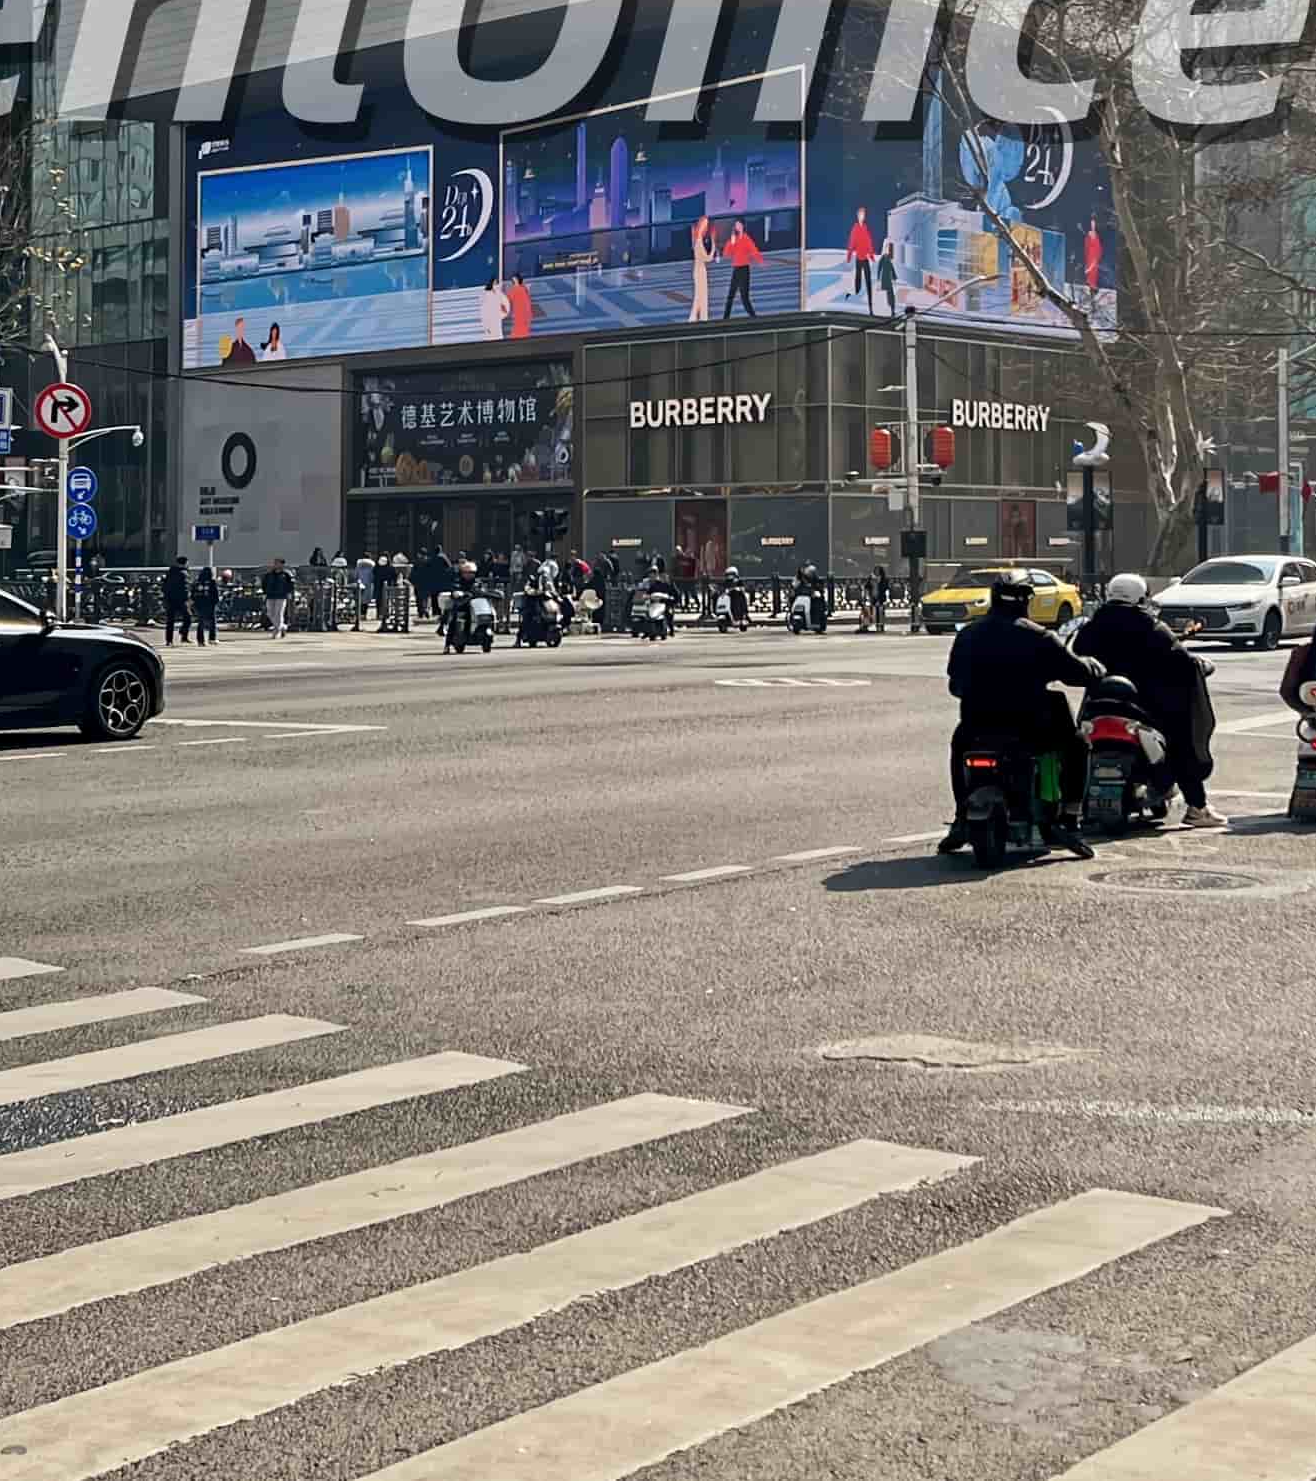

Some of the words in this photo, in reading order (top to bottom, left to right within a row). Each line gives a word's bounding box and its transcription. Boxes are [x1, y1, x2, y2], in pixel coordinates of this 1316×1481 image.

[400, 395, 538, 430] 德基艺术博物馆
[629, 392, 773, 429] BURBERRY
[952, 398, 1052, 432] BURBERRY
